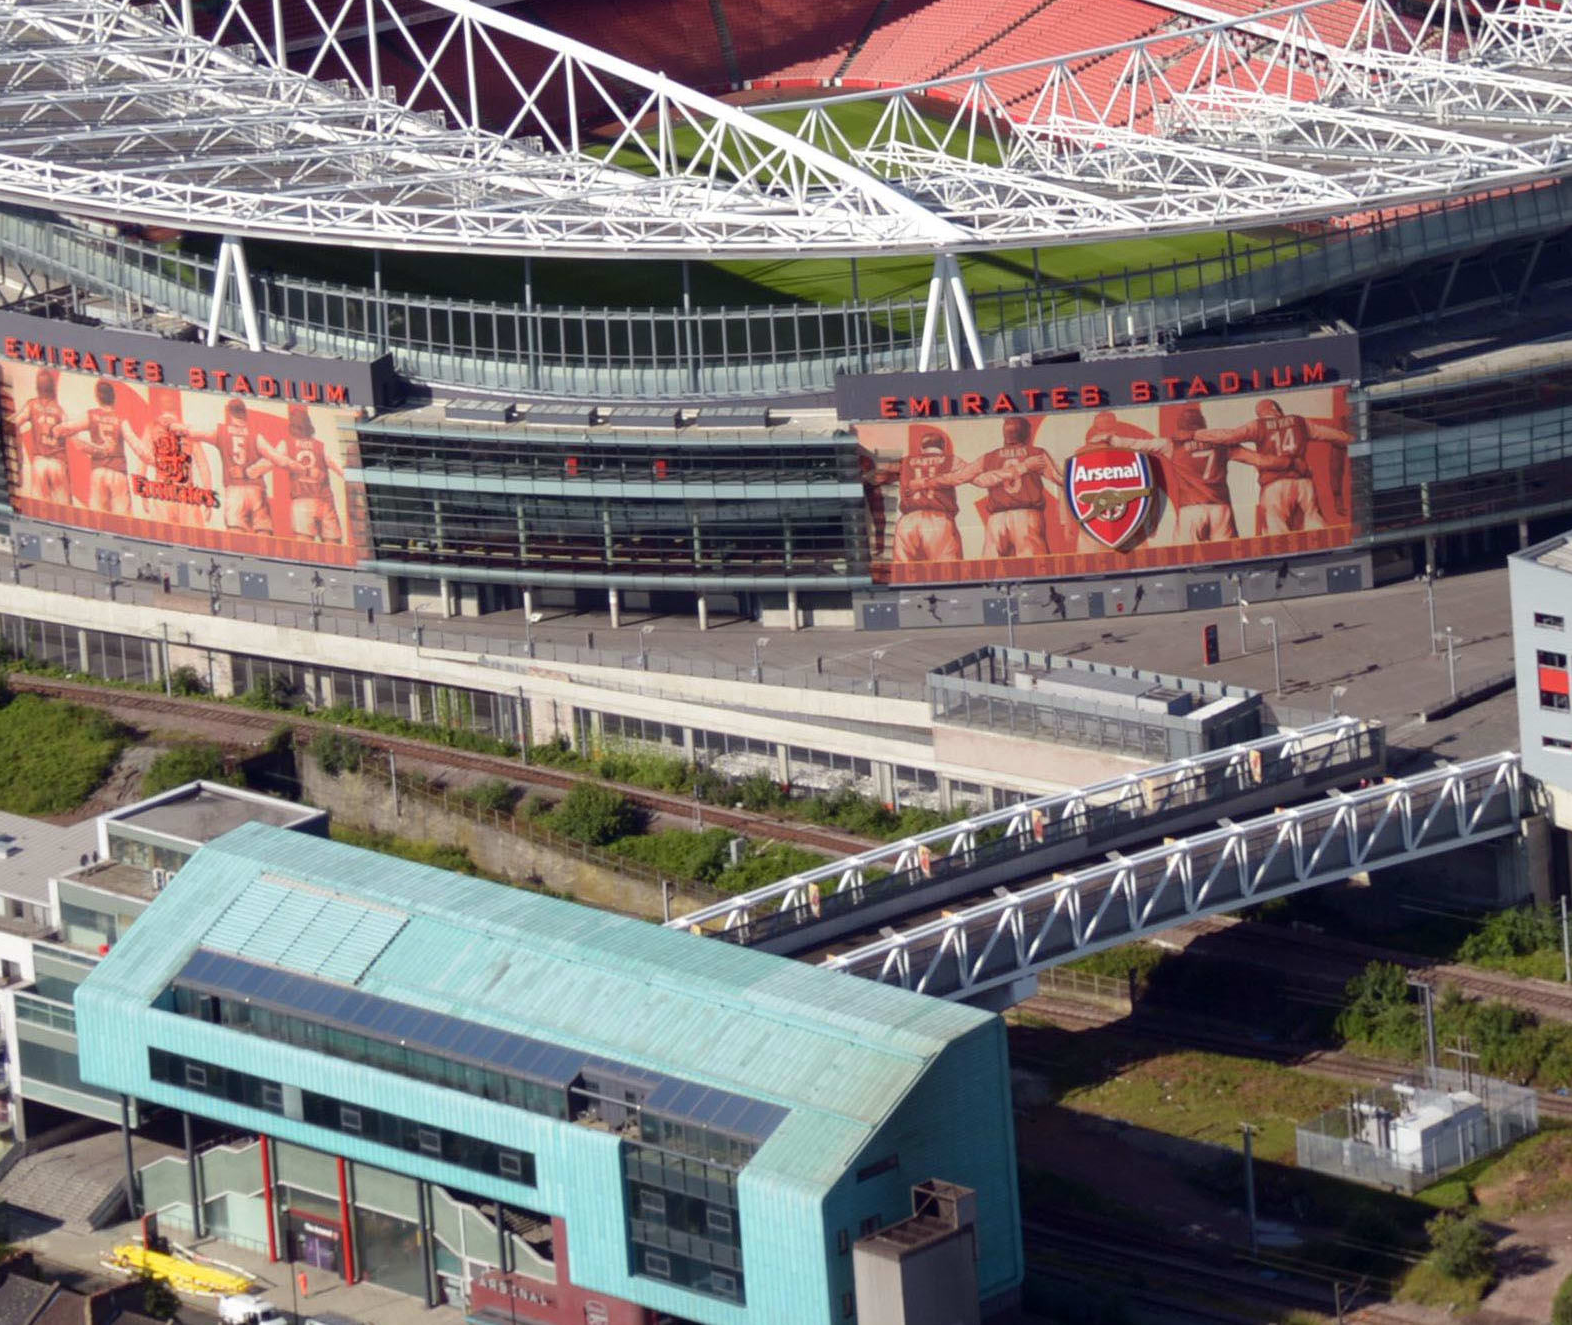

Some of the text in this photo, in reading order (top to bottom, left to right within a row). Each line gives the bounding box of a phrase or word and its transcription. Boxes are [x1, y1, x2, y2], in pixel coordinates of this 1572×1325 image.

[4, 335, 349, 405] EMIRATES STADIUM
[880, 362, 1326, 417] EMIRATES STADIUM
[132, 474, 216, 507] Emirates
[1075, 462, 1141, 482] Arsenal
